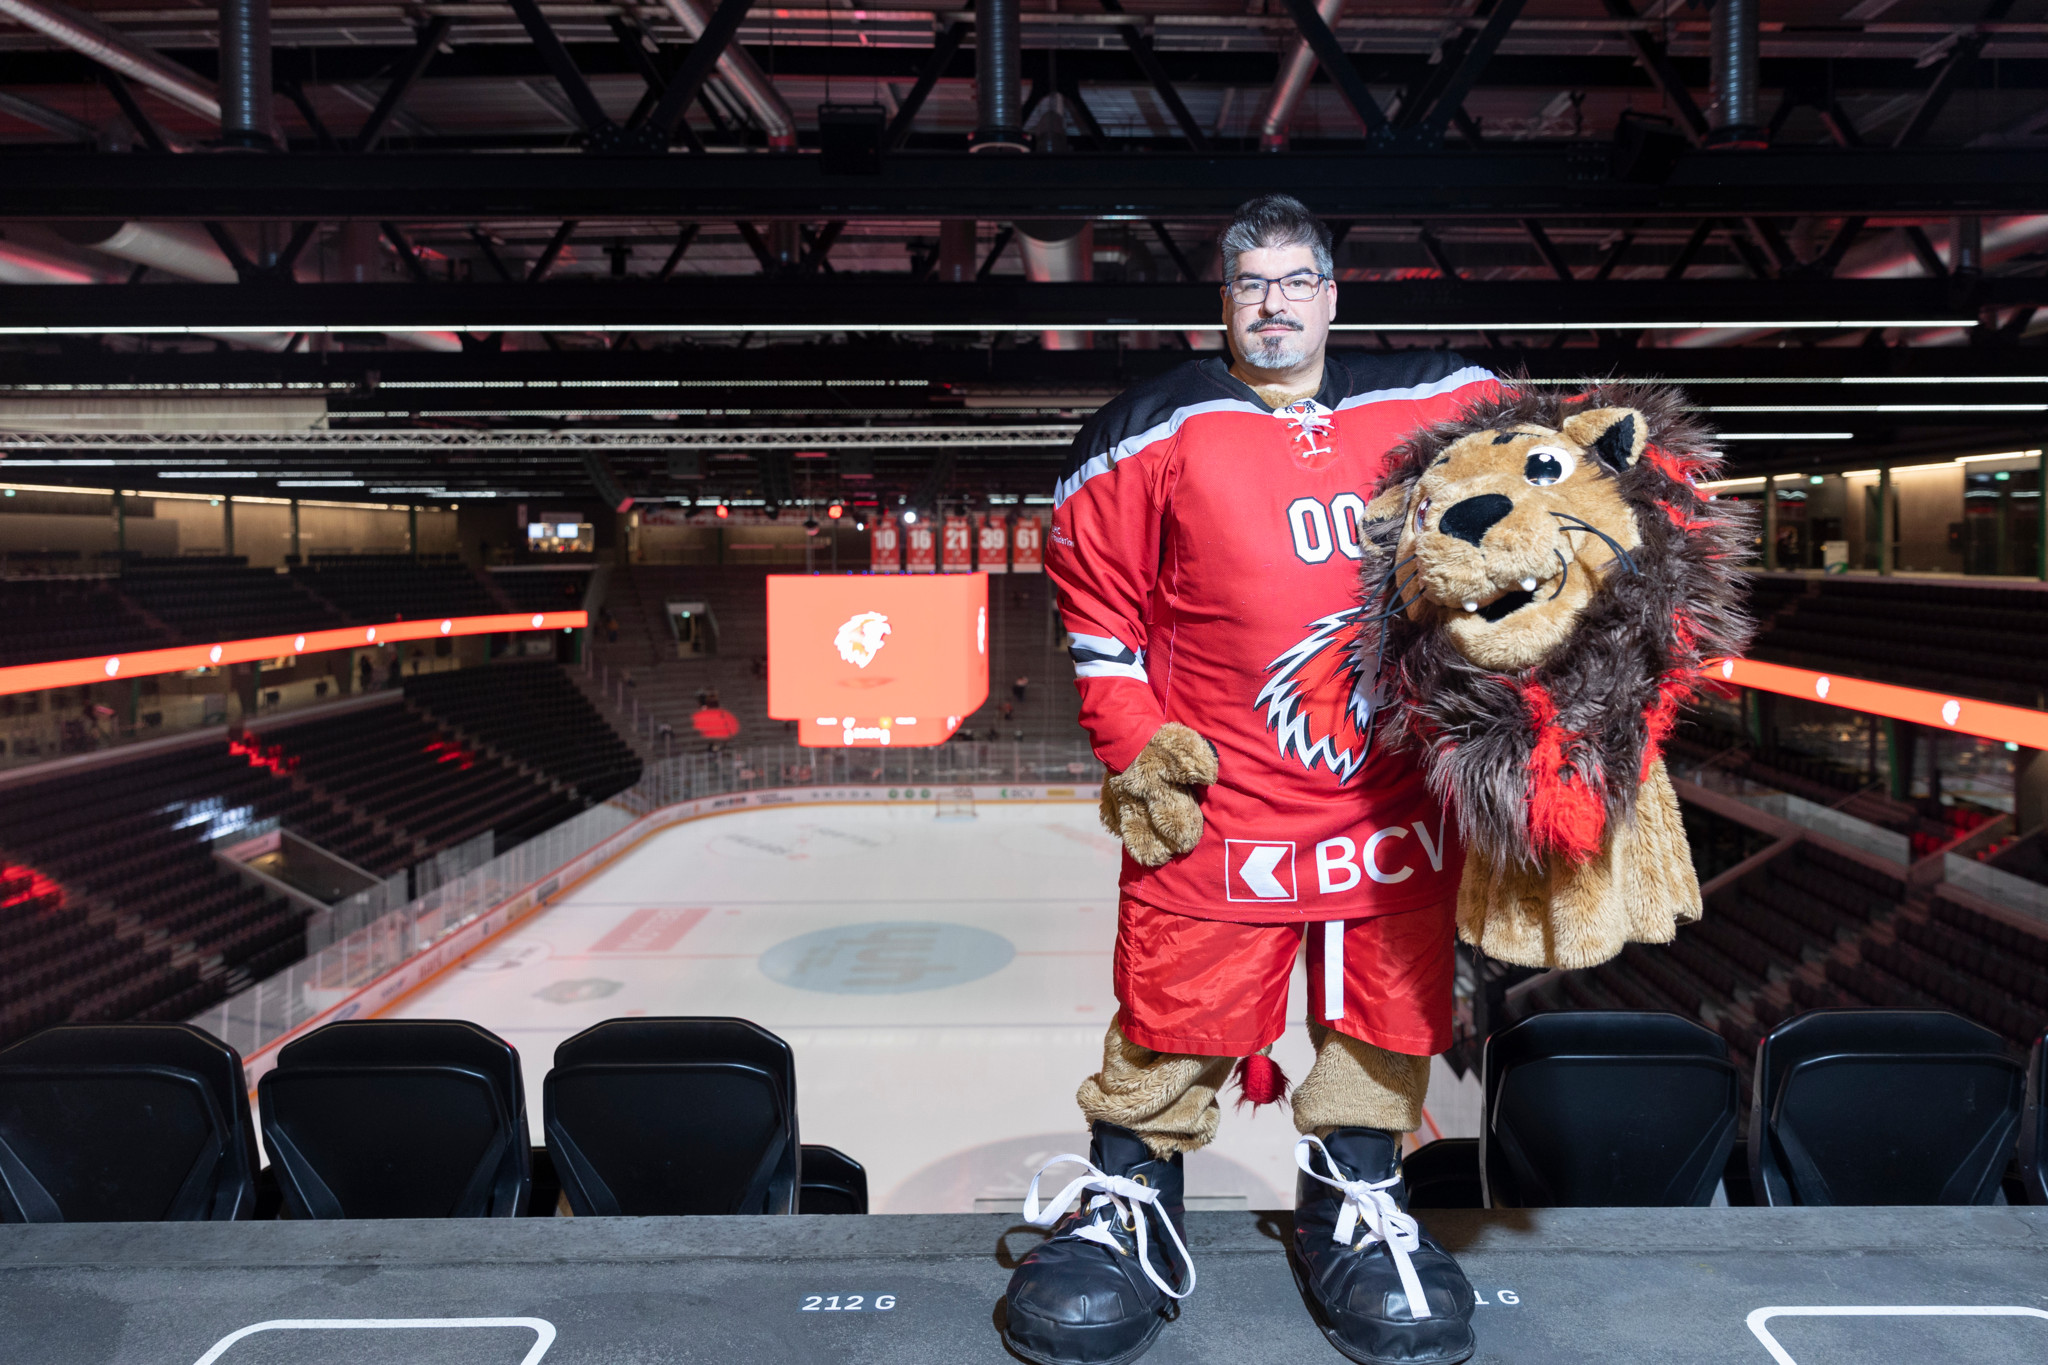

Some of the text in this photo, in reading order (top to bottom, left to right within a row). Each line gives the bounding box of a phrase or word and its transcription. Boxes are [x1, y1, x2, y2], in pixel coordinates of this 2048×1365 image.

[1286, 492, 1365, 565] 00
[874, 529, 896, 549] 10
[909, 529, 932, 549] 16
[945, 529, 968, 549] 21
[980, 529, 1005, 549] 39
[1016, 529, 1039, 549] 61
[1316, 815, 1445, 894] BCV
[802, 1295, 896, 1311] 212 G
[1497, 1290, 1520, 1305] G
